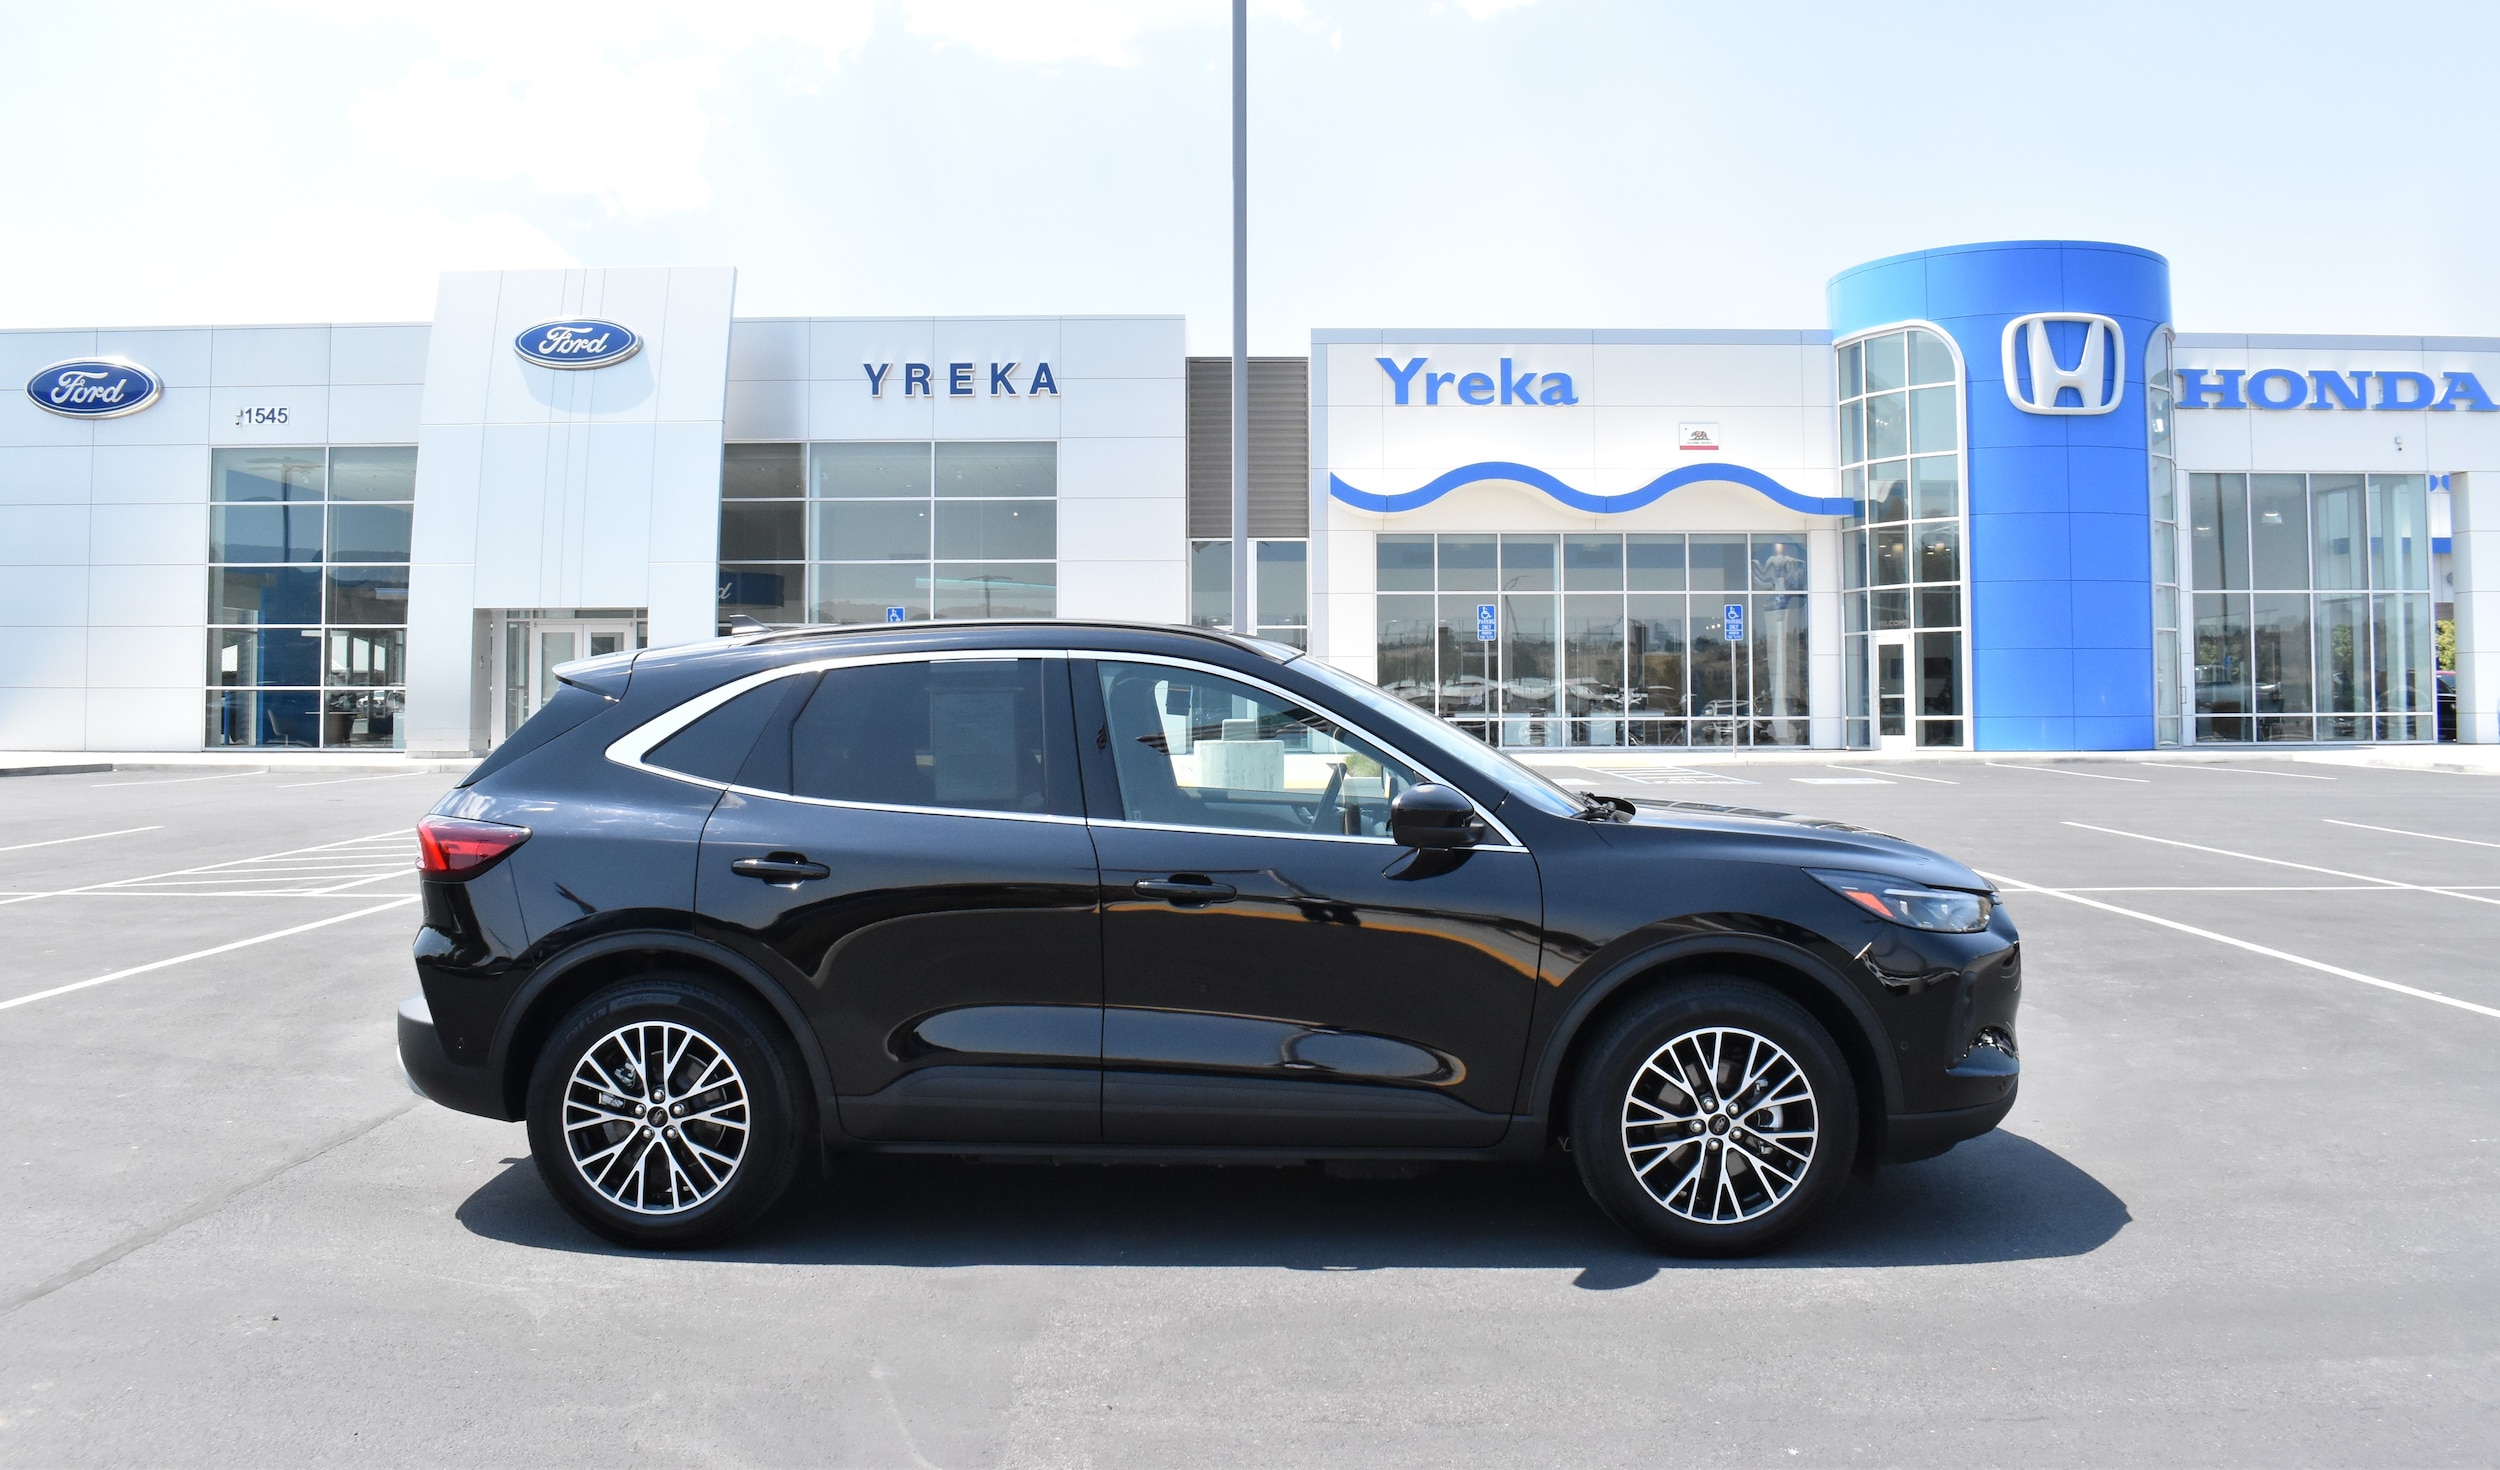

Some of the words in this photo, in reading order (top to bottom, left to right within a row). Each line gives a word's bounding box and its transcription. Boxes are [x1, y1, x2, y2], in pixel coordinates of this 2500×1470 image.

[538, 326, 611, 354] Ford
[50, 371, 127, 404] Ford
[862, 361, 1060, 397] YREKA
[1375, 357, 1579, 406] Yreka
[2175, 369, 2500, 412] HONDA
[245, 407, 288, 424] 1545
